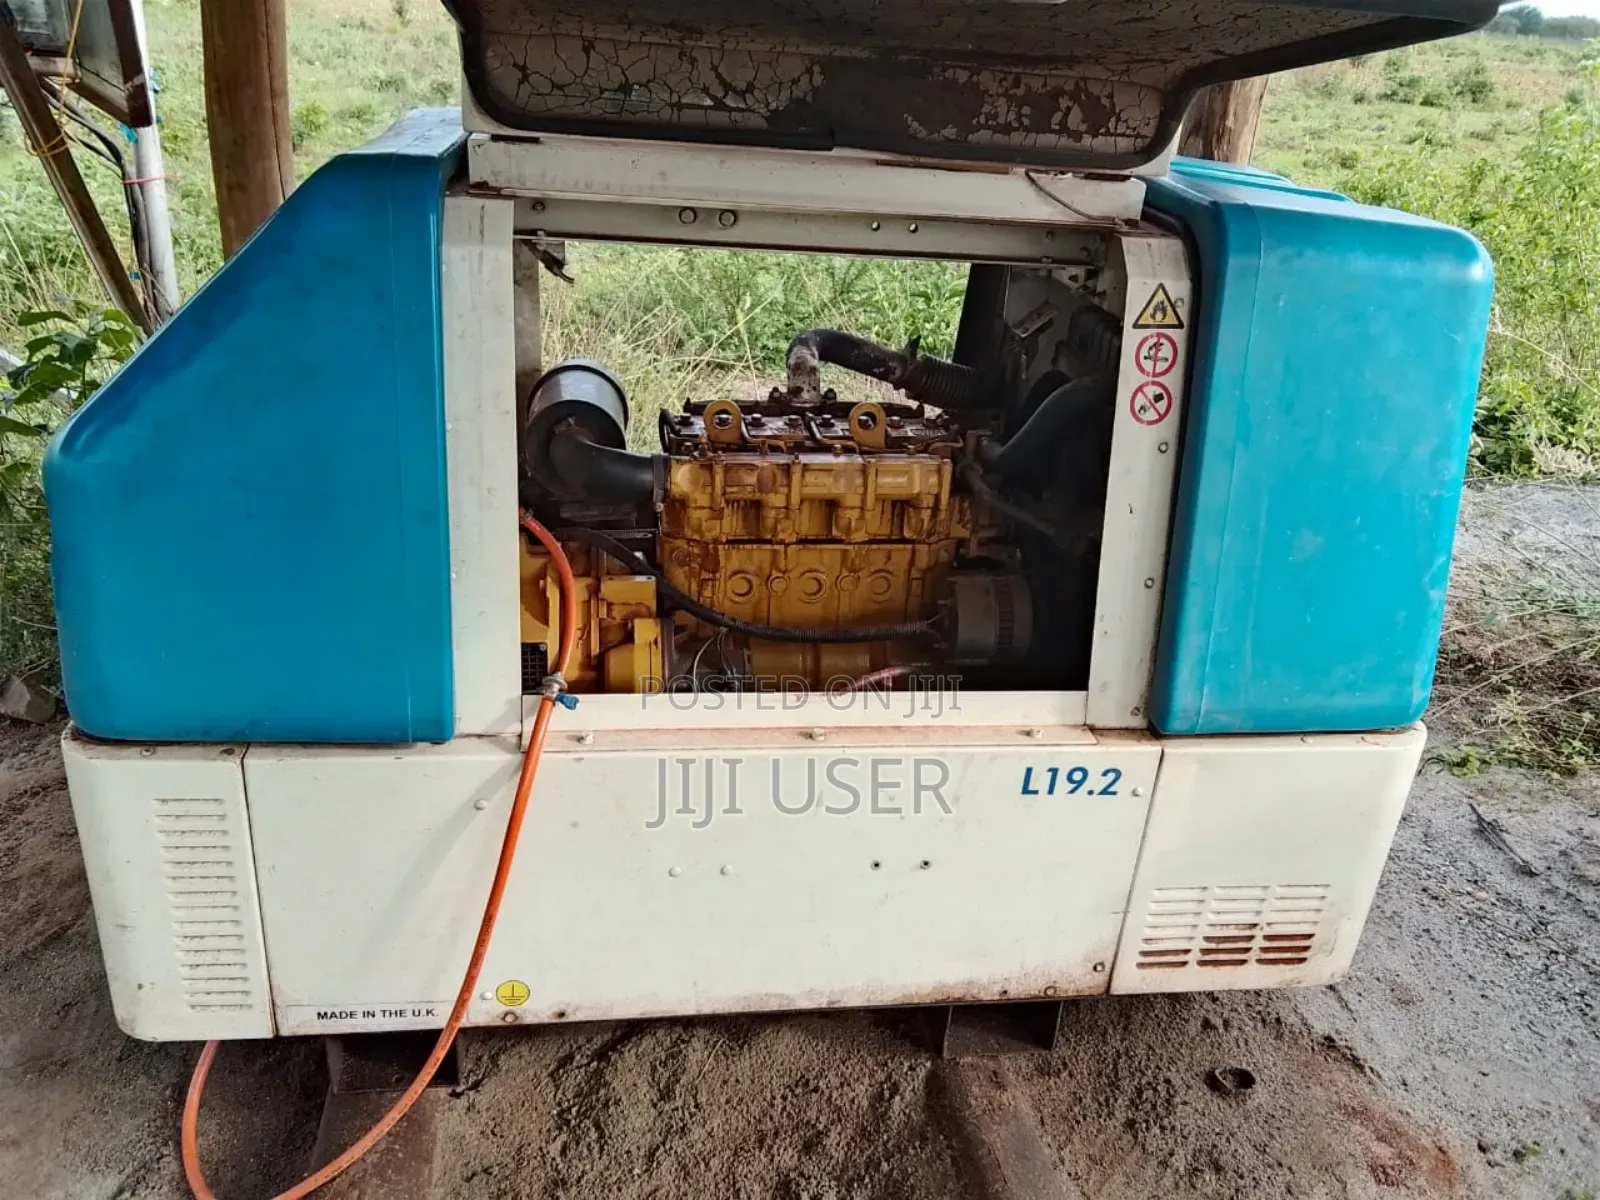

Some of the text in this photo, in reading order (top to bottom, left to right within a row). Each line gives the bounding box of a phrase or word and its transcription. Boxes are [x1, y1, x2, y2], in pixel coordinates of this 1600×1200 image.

[1020, 766, 1123, 796] L19.2
[316, 1008, 440, 1021] MADE IN THE U.K.
